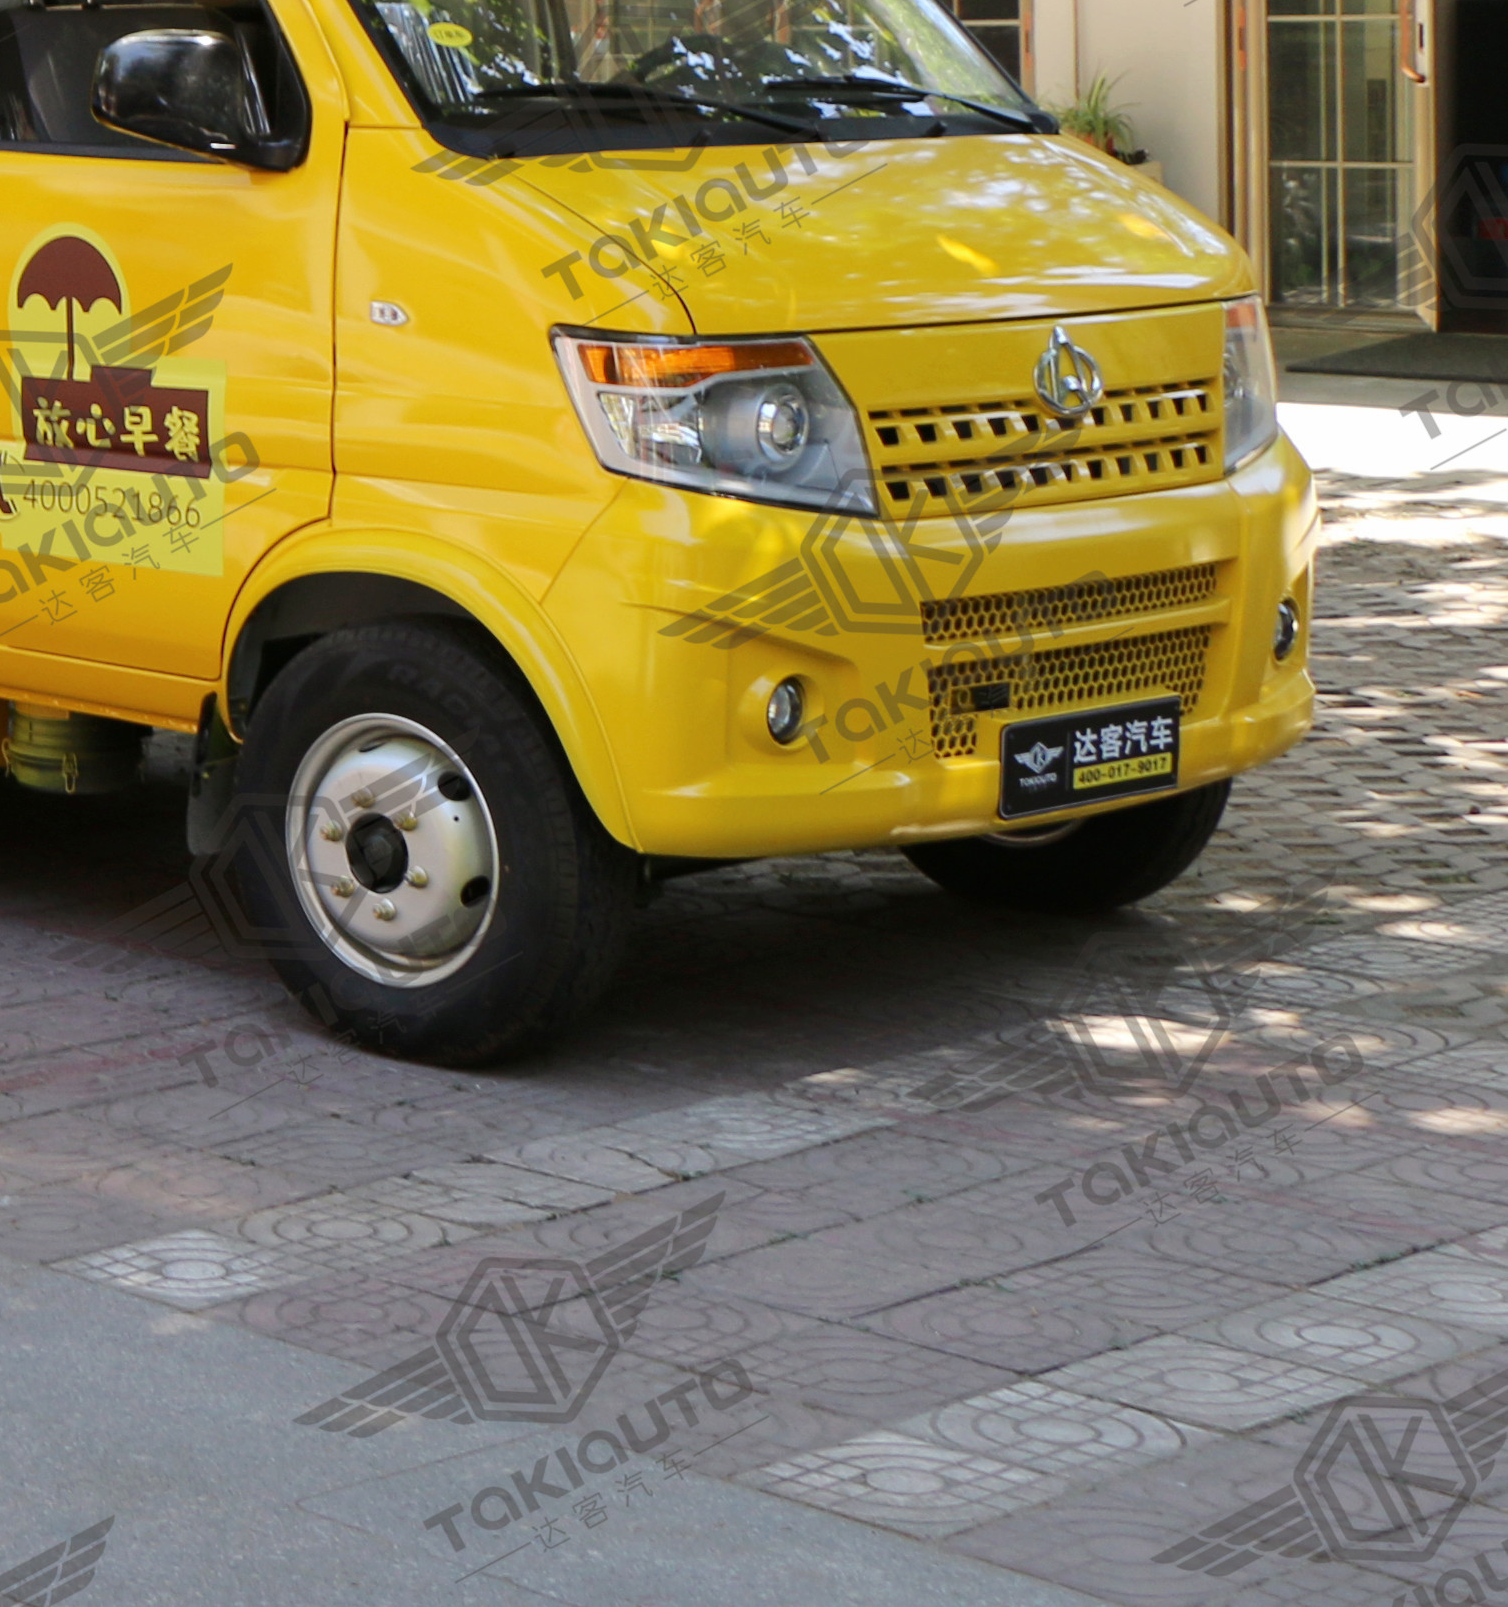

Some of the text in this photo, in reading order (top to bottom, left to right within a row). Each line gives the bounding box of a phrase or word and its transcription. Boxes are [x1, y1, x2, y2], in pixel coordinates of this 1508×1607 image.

[33, 396, 201, 463] 放心早餐
[23, 479, 201, 528] 4000521866
[1073, 715, 1174, 764] 达客汽车
[1078, 757, 1167, 785] 400-017-9017
